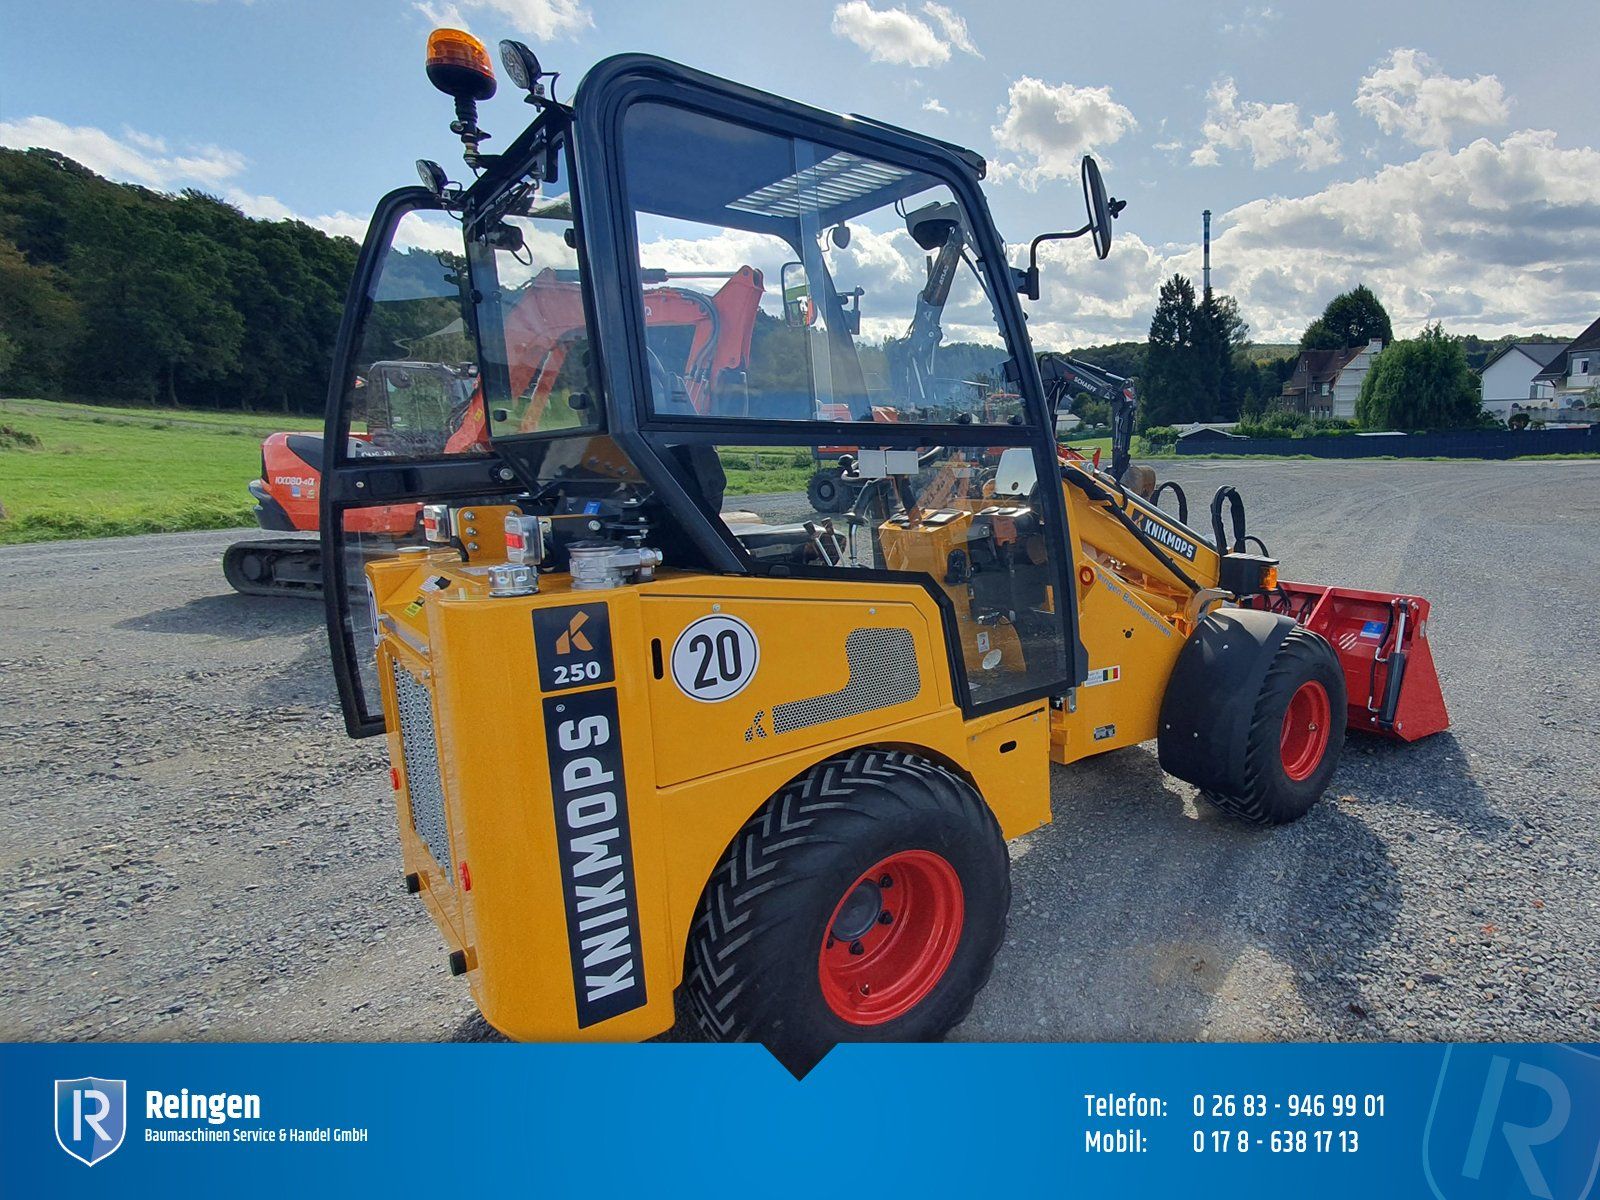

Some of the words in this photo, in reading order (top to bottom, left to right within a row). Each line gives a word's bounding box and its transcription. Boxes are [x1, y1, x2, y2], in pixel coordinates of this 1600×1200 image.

[1073, 376, 1097, 393] SCHAEFF
[1144, 519, 1194, 558] KNIKMOPS
[553, 661, 601, 685] 250
[688, 629, 742, 690] 20
[557, 714, 636, 1002] KNIKMOPS
